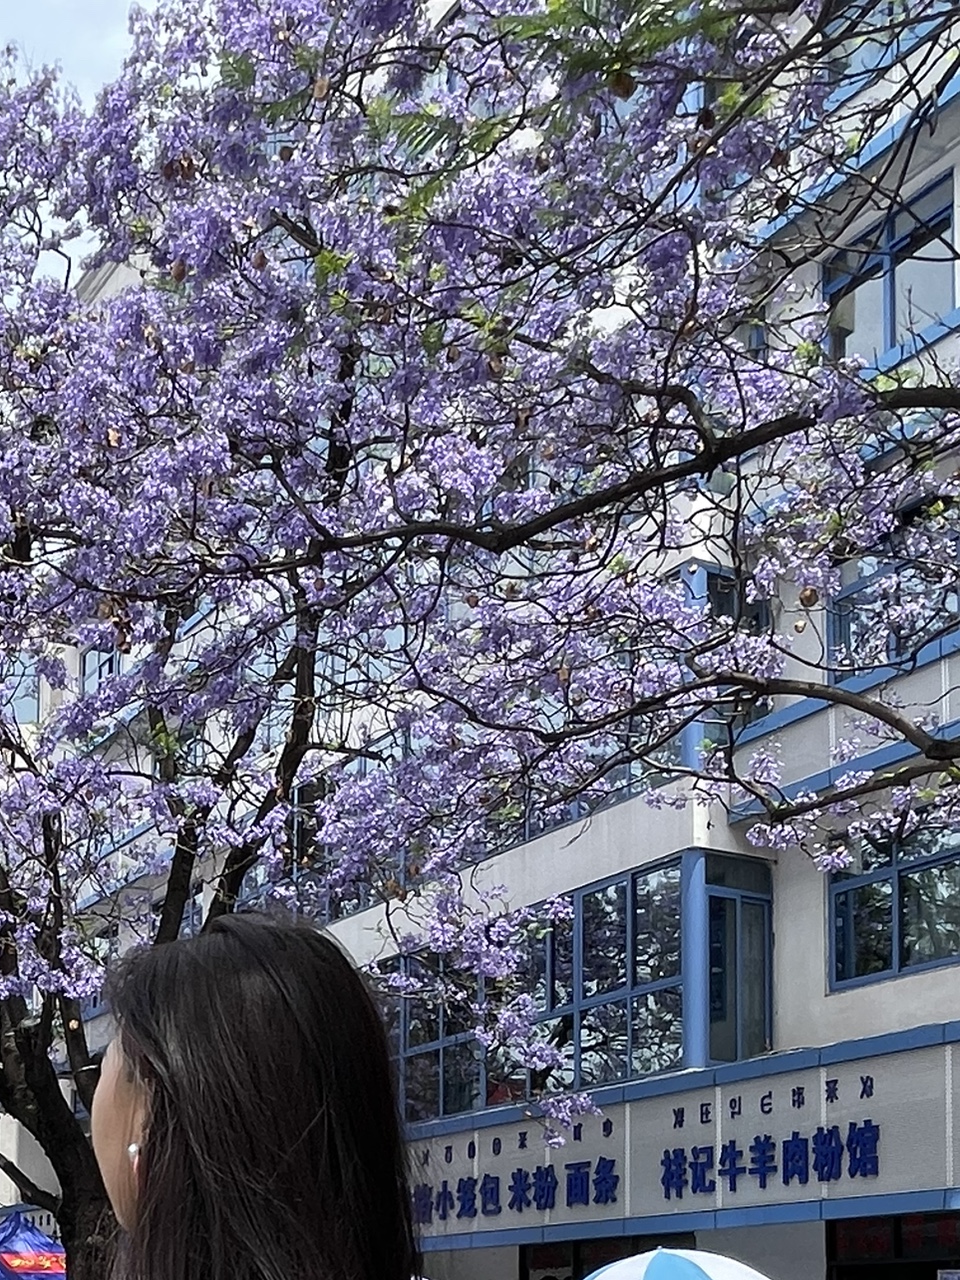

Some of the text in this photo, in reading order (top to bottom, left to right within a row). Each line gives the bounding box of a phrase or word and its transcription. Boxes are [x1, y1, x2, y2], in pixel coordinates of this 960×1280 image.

[564, 1155, 620, 1208] 面条
[661, 1119, 881, 1200] 祥记牛羊肉粉馆
